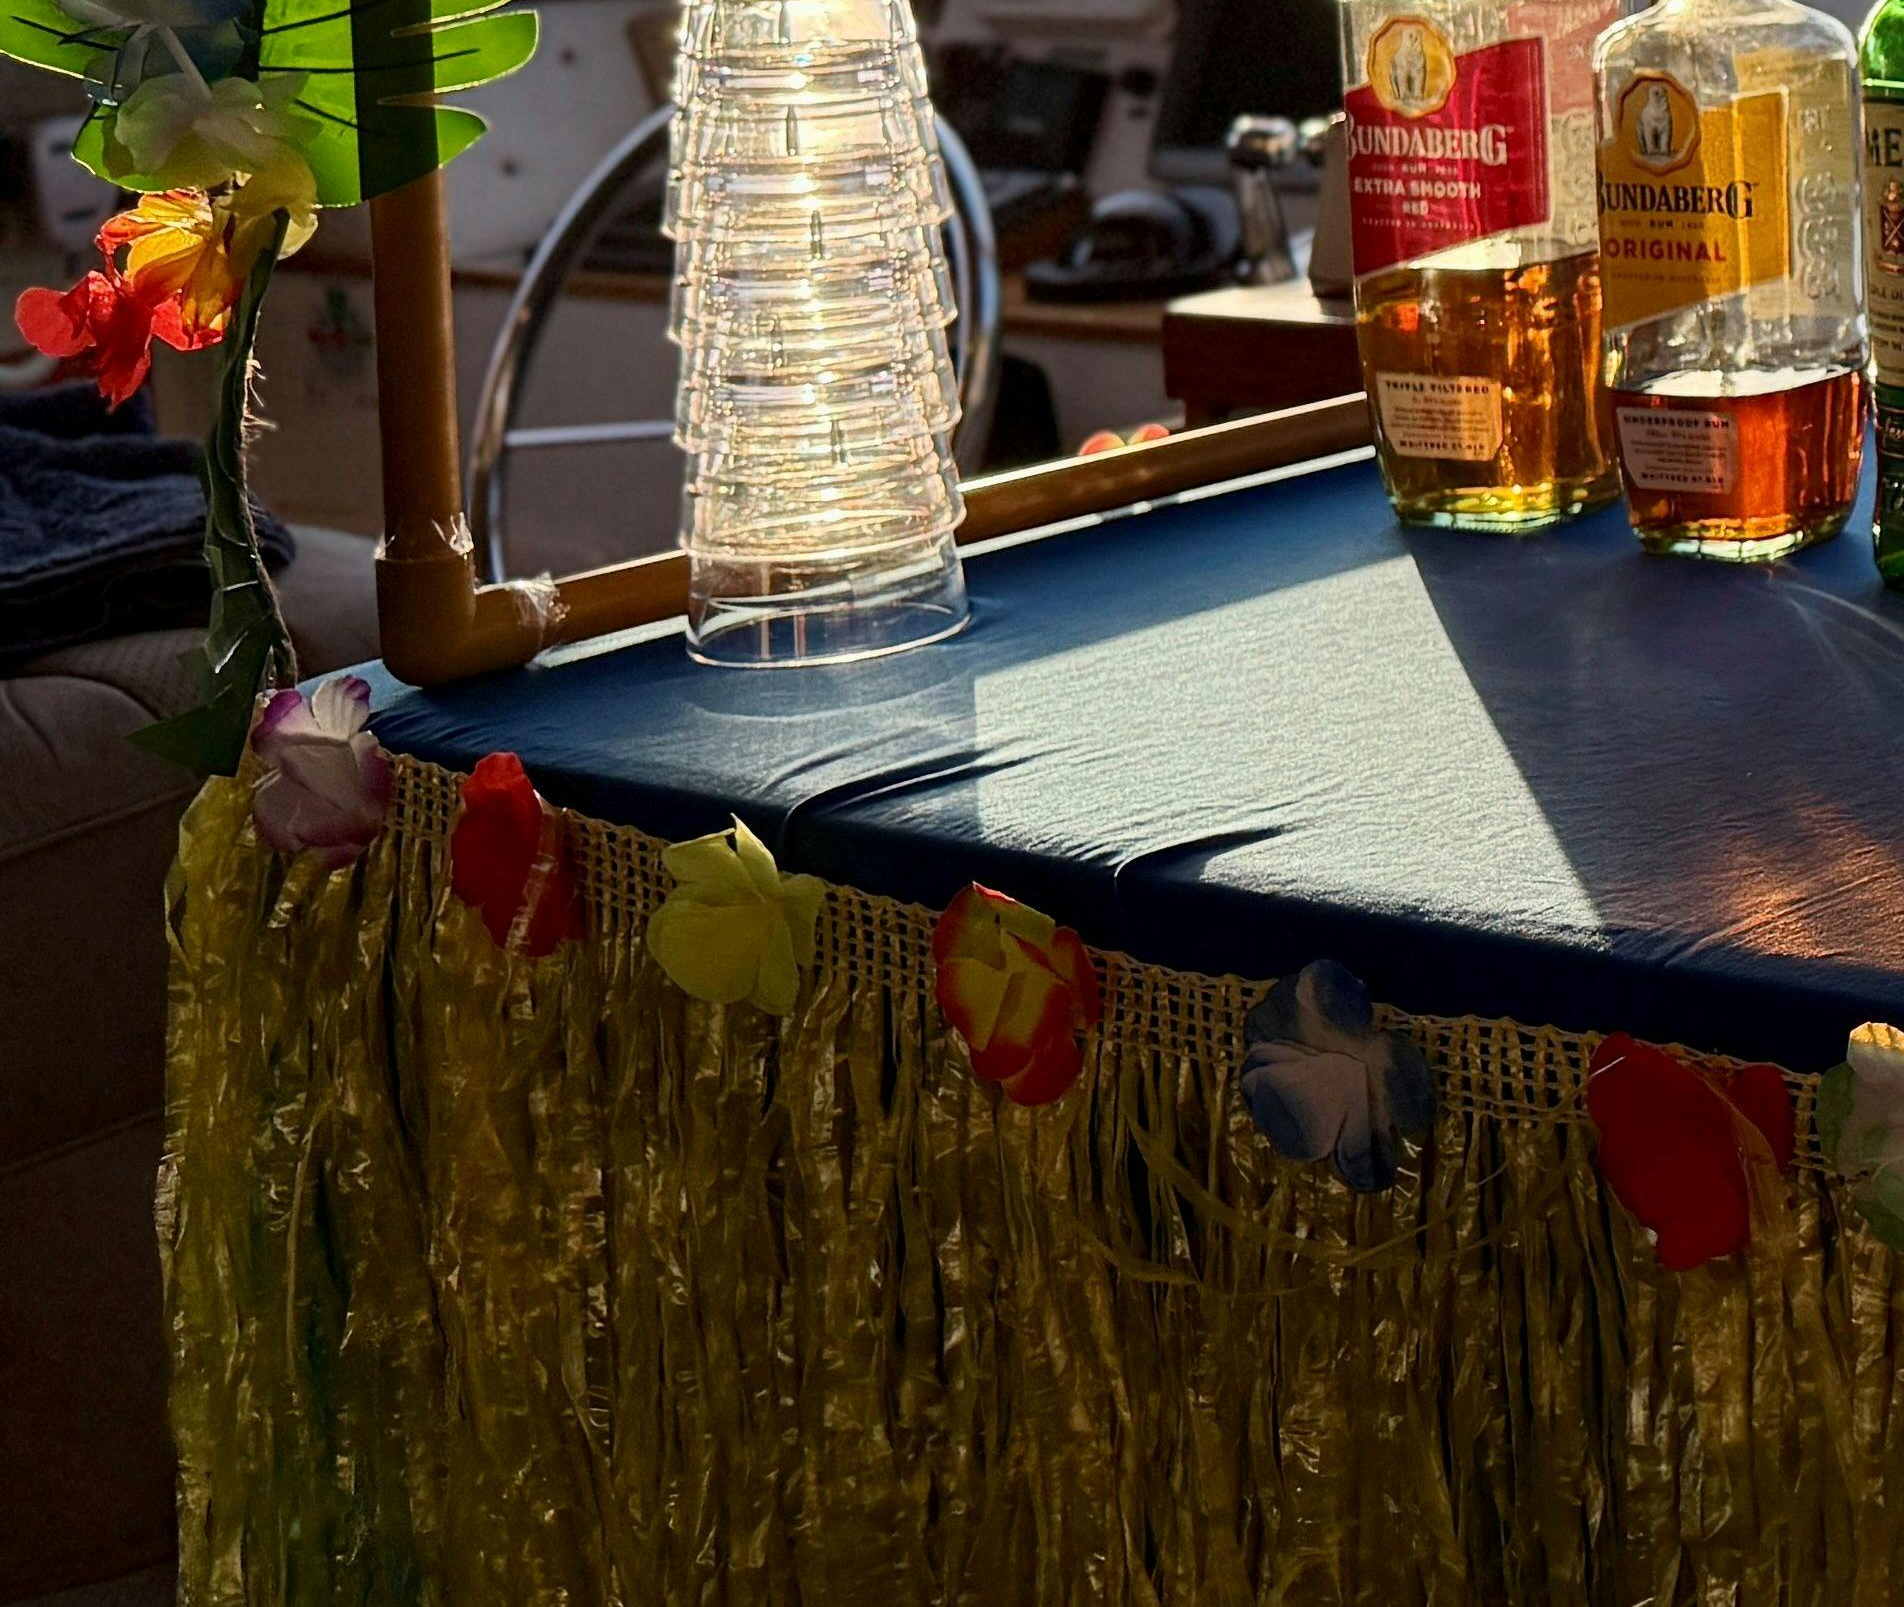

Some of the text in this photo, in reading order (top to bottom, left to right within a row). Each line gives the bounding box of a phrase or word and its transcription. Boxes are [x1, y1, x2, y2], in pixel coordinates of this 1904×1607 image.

[1344, 111, 1508, 166] BUNDABERG
[1354, 177, 1481, 199] EXTRA SMOOTH
[1598, 170, 1754, 220] BUNDABERG
[1606, 238, 1727, 263] ORIGINAL
